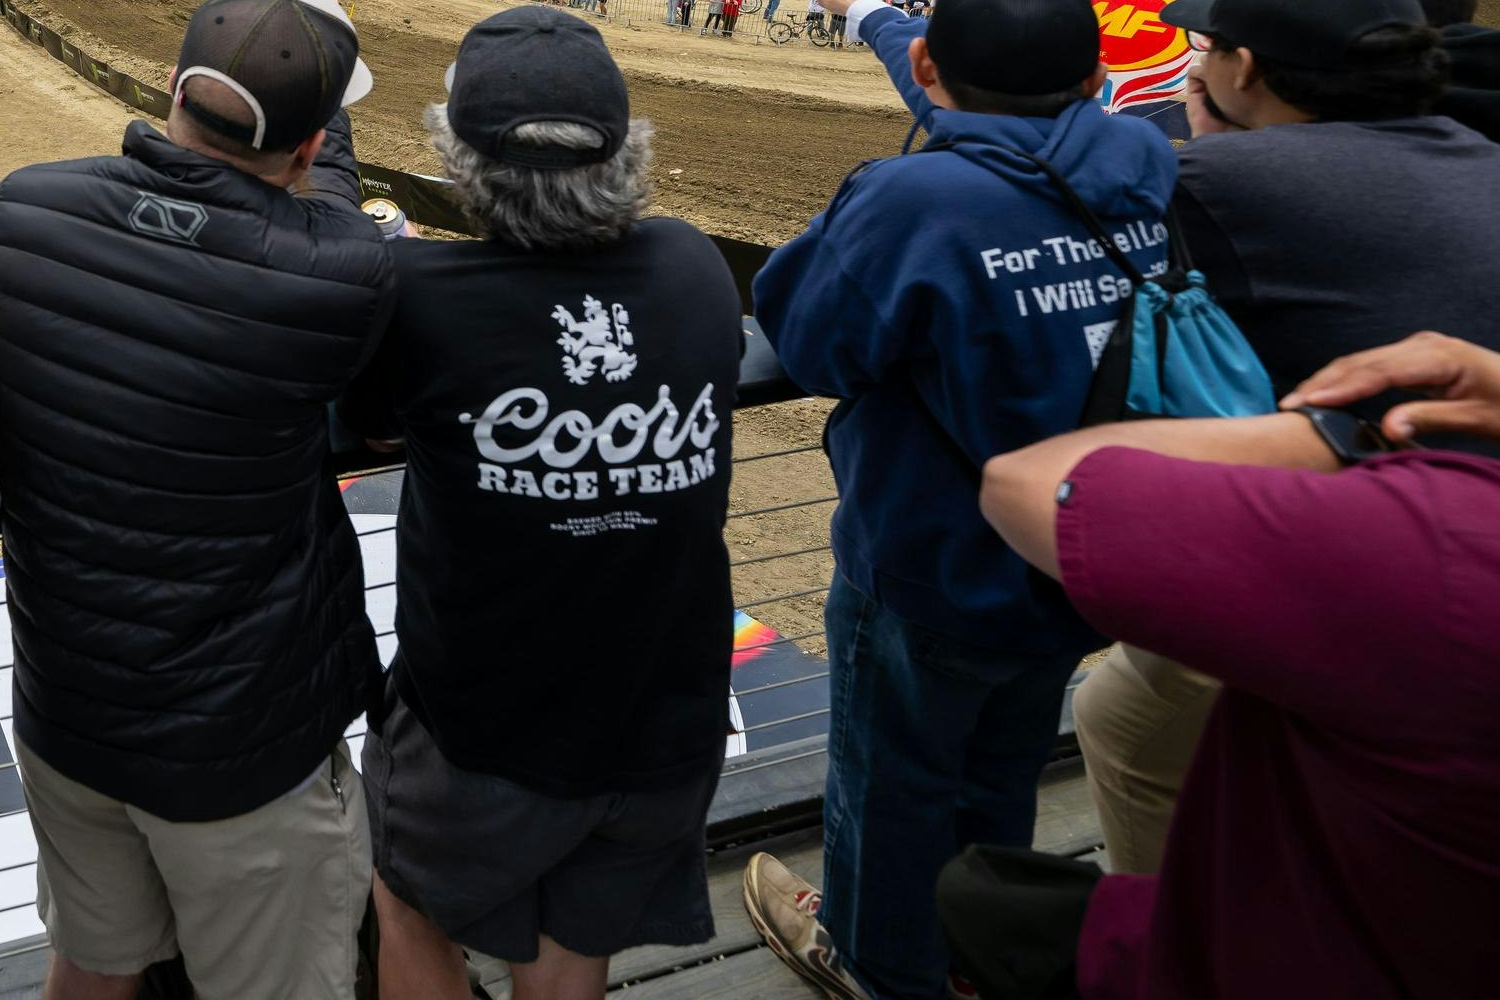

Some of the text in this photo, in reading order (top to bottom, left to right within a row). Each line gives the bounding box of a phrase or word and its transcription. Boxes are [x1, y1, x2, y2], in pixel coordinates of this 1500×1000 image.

[1092, 1, 1167, 39] MF
[362, 177, 392, 192] MONSTER
[980, 246, 1041, 280] For
[1042, 231, 1132, 266] Thoe
[1014, 288, 1029, 317] I
[1032, 279, 1098, 315] Will
[458, 382, 720, 469] Coors
[477, 447, 716, 500] RACE TEAM
